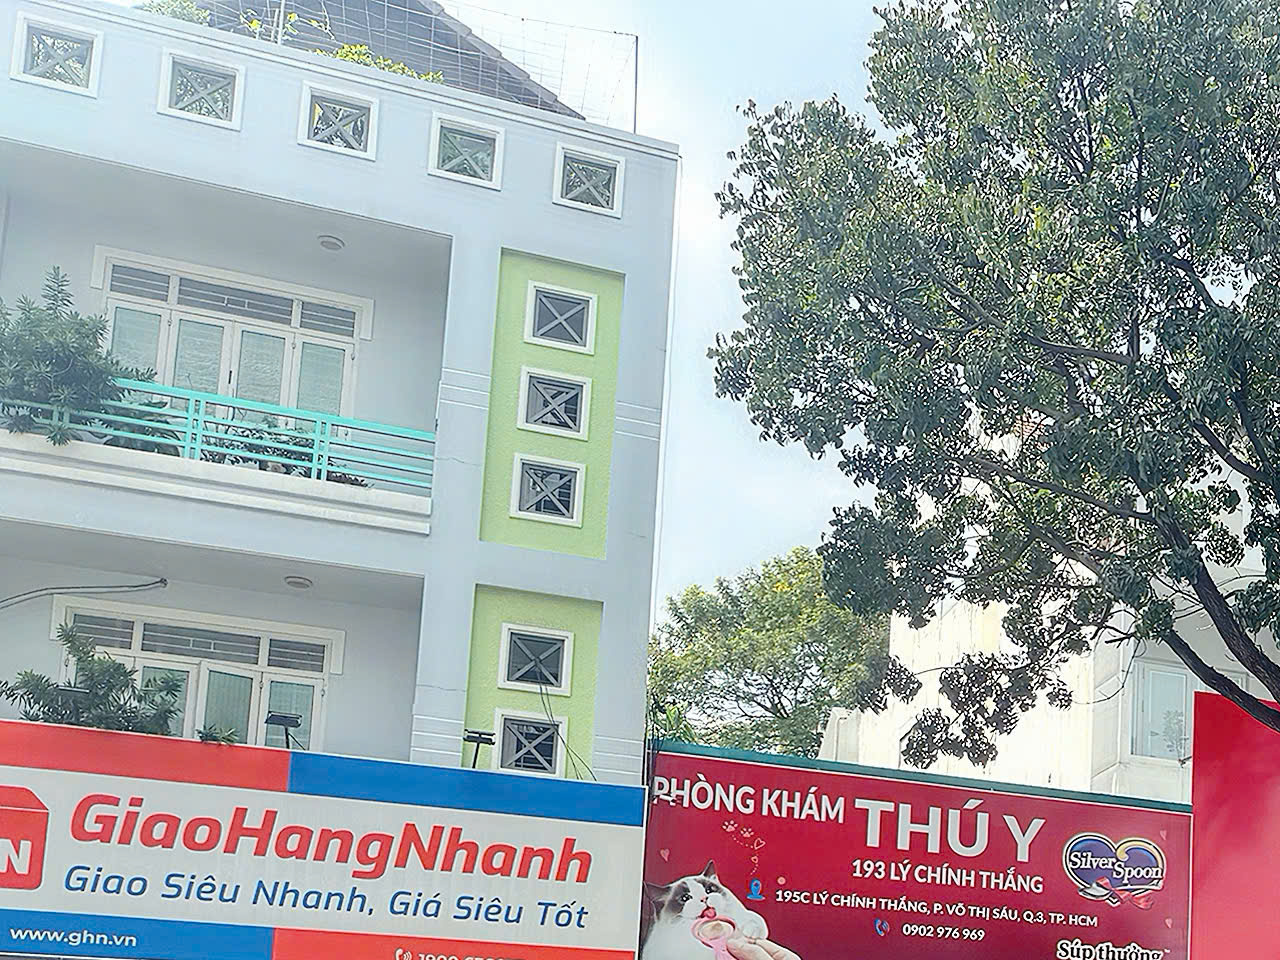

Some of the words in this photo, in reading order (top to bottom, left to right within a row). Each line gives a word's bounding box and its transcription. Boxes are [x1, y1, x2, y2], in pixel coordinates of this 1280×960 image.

[653, 773, 755, 815] PHÒNG
[762, 787, 844, 824] KHÁM
[70, 793, 592, 883] GiaoHangNhanh
[855, 798, 989, 858] THÚ
[1003, 815, 1046, 863] Y
[852, 859, 886, 879] 193
[890, 860, 911, 881] LÝ
[914, 863, 975, 887] CHÍNH
[979, 867, 1044, 893] THẮNG
[1069, 852, 1117, 870] Silver
[1112, 862, 1164, 884] Spoon
[64, 865, 148, 897] Giao
[161, 873, 241, 904] Siêu
[252, 880, 374, 916] Nhanh,
[389, 890, 441, 918] Giá
[453, 895, 523, 924] Siêu
[537, 901, 589, 928] Tốt
[775, 890, 811, 904] 195C
[813, 890, 829, 905] LÝ
[831, 891, 876, 909] CHÍNH
[879, 895, 931, 915] THẮNG,
[934, 903, 944, 914] P.
[945, 902, 966, 916] VÕ
[968, 906, 990, 921] THỊ
[992, 906, 1021, 922] SÁU,
[1023, 910, 1047, 925] Q.3,
[1049, 913, 1066, 925] TP.
[1068, 914, 1098, 927] HCM
[10, 928, 137, 947] www.ghn.vn
[902, 924, 934, 937] 0902
[936, 925, 959, 939] 976
[962, 928, 986, 941] 969
